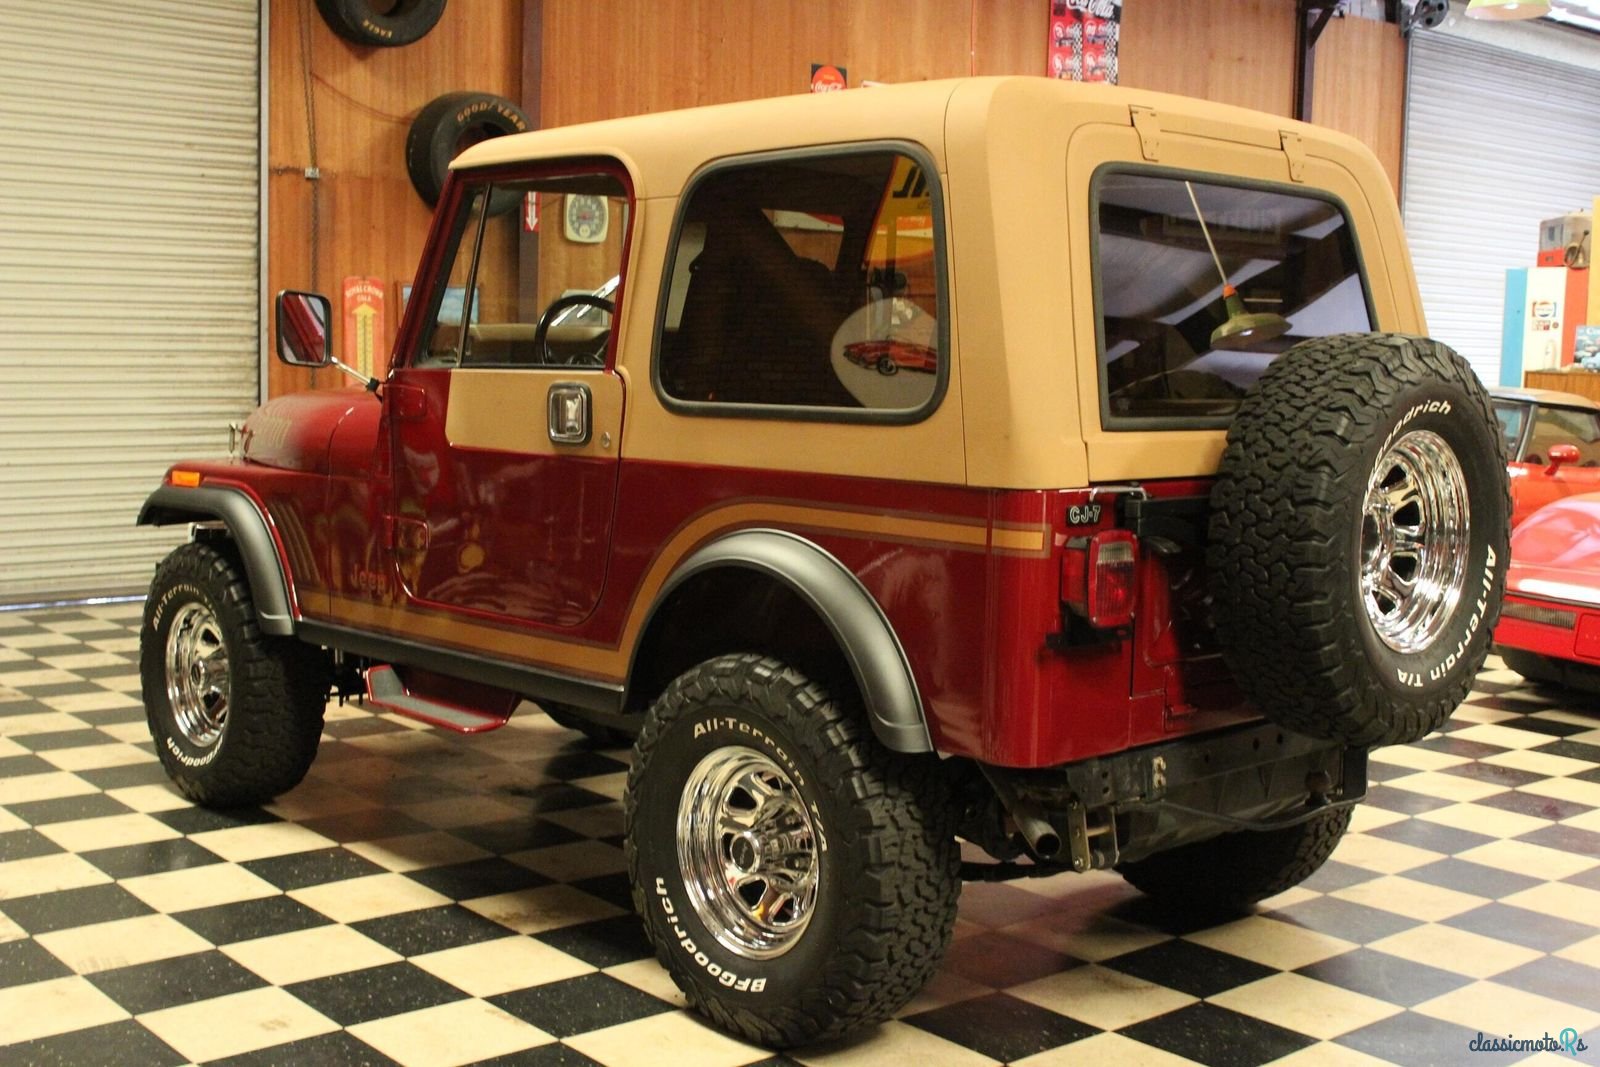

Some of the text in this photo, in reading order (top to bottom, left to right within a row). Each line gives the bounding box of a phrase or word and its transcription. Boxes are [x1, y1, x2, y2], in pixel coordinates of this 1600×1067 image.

[1069, 505, 1101, 524] CJ-7
[153, 584, 200, 632] All-Terrain
[1397, 544, 1497, 687] All-Terrain T/A
[693, 717, 804, 786] All-Terrain
[656, 877, 767, 993] BFGoodrich
